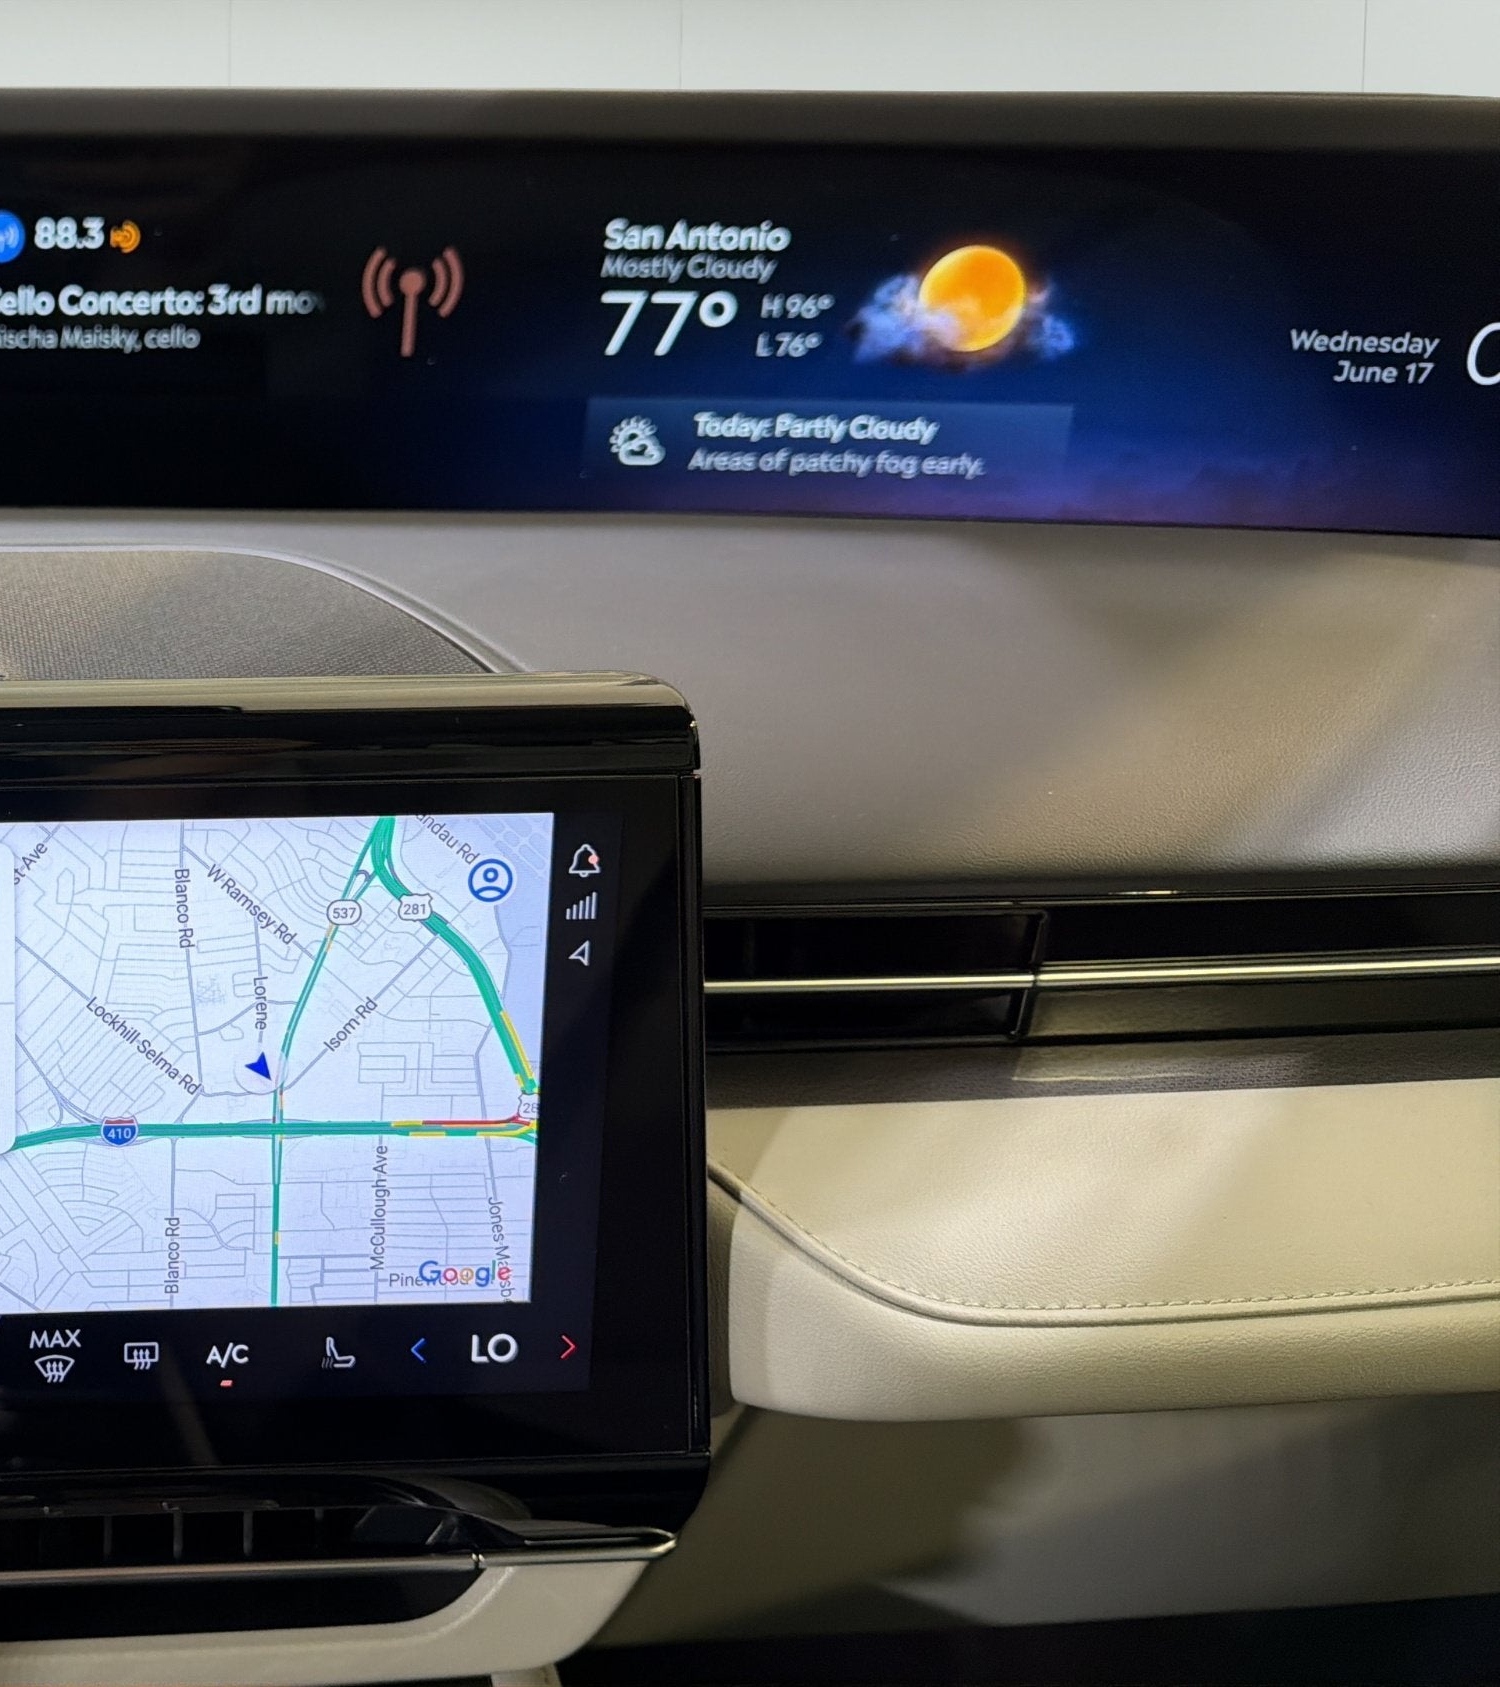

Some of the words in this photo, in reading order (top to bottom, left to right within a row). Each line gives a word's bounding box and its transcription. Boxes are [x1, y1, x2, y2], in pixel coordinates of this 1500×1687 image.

[34, 216, 105, 250] 88.3
[603, 217, 665, 251] San
[664, 218, 792, 252] Antonio
[600, 252, 687, 284] Mostly
[686, 252, 779, 285] Cloudy
[58, 284, 205, 317] Concerto:
[206, 284, 263, 317] 3rd
[759, 293, 786, 319] H
[785, 293, 836, 319] 96°
[59, 324, 142, 355] Maisky,
[143, 322, 201, 350] cello
[600, 289, 739, 357] 77°
[755, 331, 775, 358] L
[774, 332, 825, 358] 76°
[1289, 328, 1441, 360] Wednesday
[1332, 359, 1399, 384] June
[1404, 361, 1436, 385] 17
[692, 411, 773, 443] Today:
[773, 412, 850, 444] Partly
[848, 413, 941, 446] Cloudy
[687, 447, 759, 472] Areas
[757, 446, 792, 472] of
[788, 449, 876, 478] patchy
[874, 450, 921, 480] fog
[921, 451, 988, 481] early.
[21, 842, 48, 871] Ave
[455, 842, 482, 866] Rd
[174, 867, 190, 924] Blanco
[206, 863, 227, 885] W
[218, 876, 277, 930] Ramsey
[271, 921, 298, 946] Rd
[403, 902, 428, 916] 281
[332, 906, 357, 920] 537
[178, 927, 196, 949] Rd
[252, 975, 269, 1031] Lorene
[322, 1013, 361, 1052] Isom
[355, 996, 379, 1021] Rd
[85, 996, 140, 1046] Lockhill
[136, 1038, 181, 1080] Selma
[176, 1071, 202, 1096] Rd
[107, 1127, 132, 1140] 410
[372, 1144, 389, 1175] Ave
[164, 1216, 181, 1240] Rd
[370, 1178, 391, 1271] McCullough
[487, 1196, 506, 1243] Jones
[164, 1244, 181, 1295] Blanco
[418, 1259, 512, 1288] Google
[29, 1329, 81, 1349] MAX
[205, 1341, 250, 1368] A/C
[470, 1333, 519, 1364] LO
